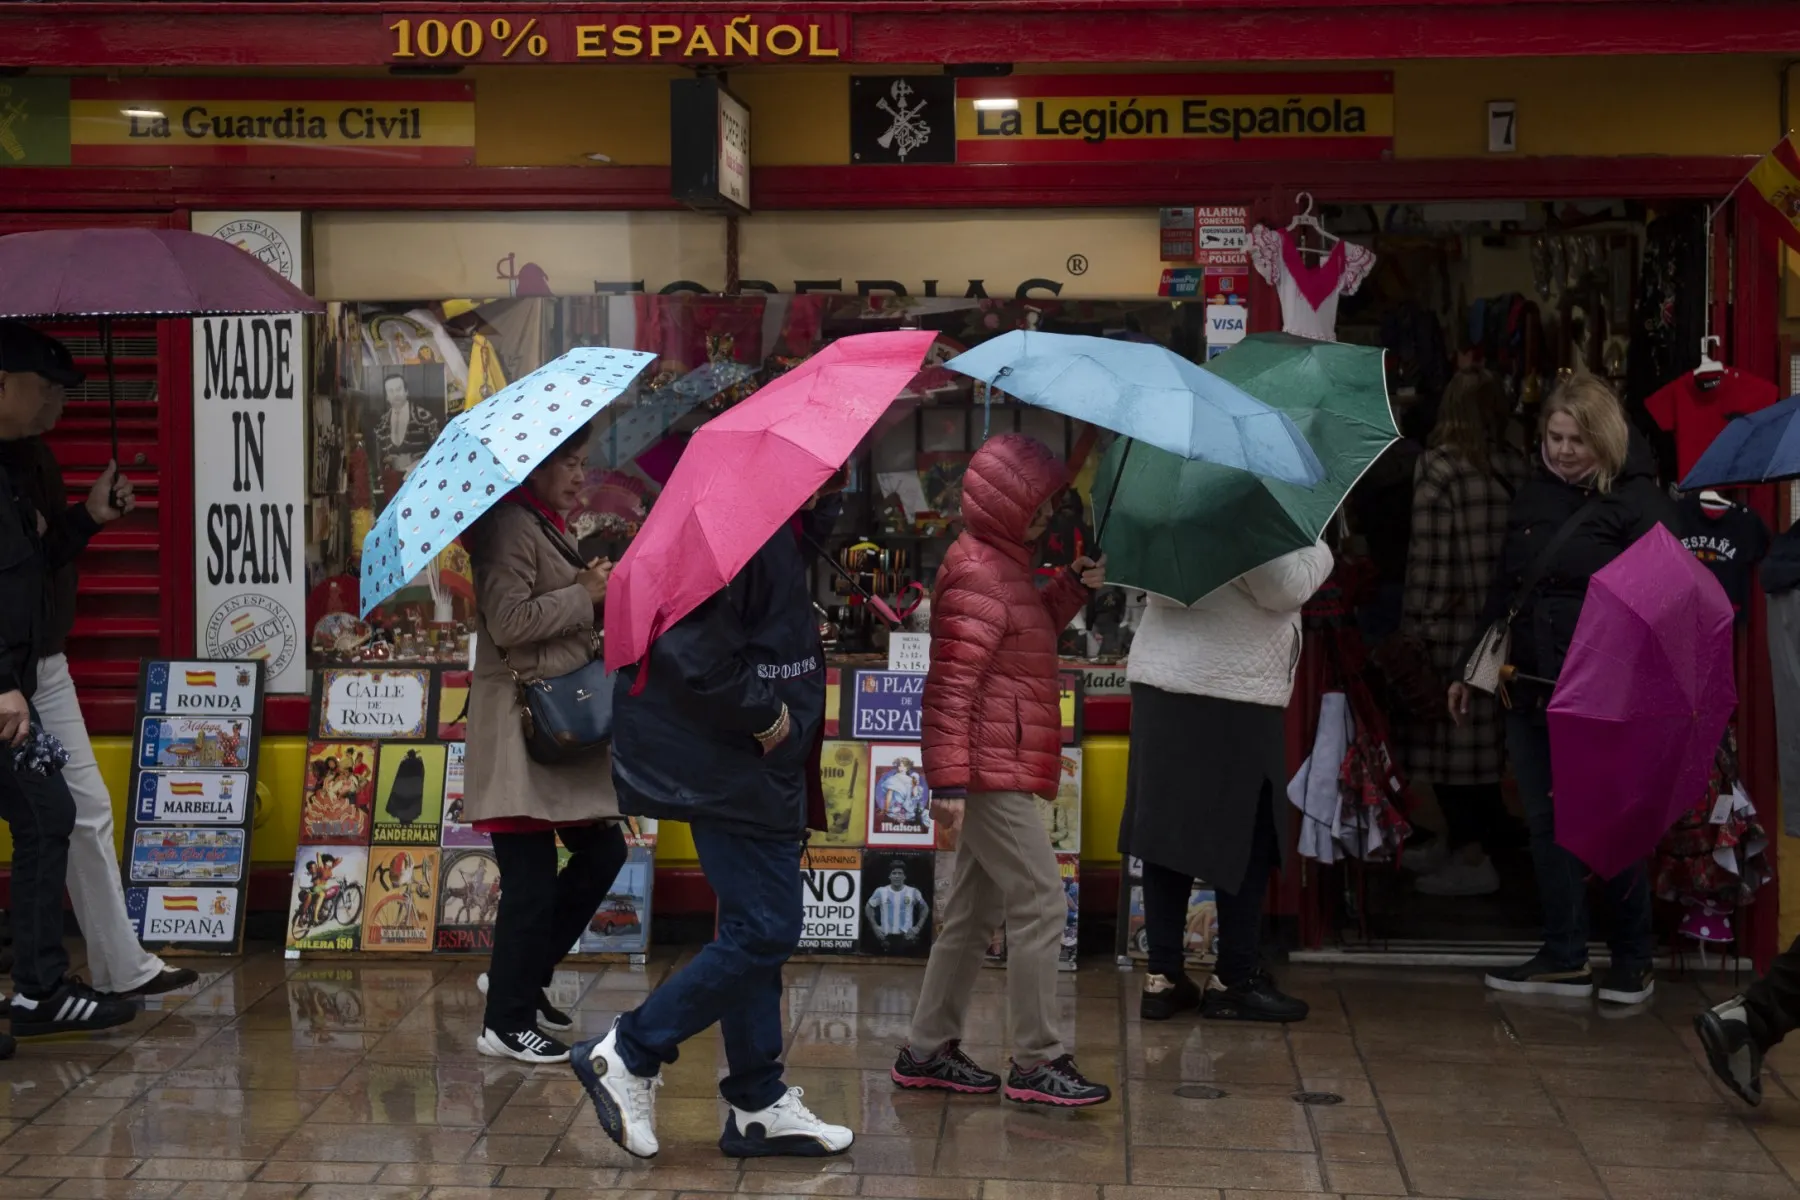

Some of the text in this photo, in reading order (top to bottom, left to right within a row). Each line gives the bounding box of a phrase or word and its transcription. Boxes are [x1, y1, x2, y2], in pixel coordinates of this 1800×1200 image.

[389, 15, 839, 58] 100% ESPAÑOL
[128, 107, 422, 139] La Guardia Civil
[977, 98, 1366, 142] La Legión Española
[1492, 111, 1514, 145] 7
[1198, 207, 1247, 217] ALARMA
[1199, 217, 1245, 225] CONECTADA
[1223, 237, 1244, 246] 24 h
[1212, 318, 1244, 330] VISA
[203, 318, 293, 400] MADE
[232, 411, 265, 492] IN
[207, 502, 293, 585] SPAIN
[1681, 536, 1737, 560] ESPAÑA
[208, 611, 224, 657] HECHO
[224, 599, 240, 612] EN
[221, 619, 281, 659] PRODUCT
[756, 655, 817, 679] SPORTS
[895, 660, 901, 669] 3
[346, 681, 405, 698] CALLE
[883, 677, 923, 694] PLAZ
[150, 692, 242, 710] E RONDA
[367, 701, 382, 710] DE
[901, 697, 913, 706] DE
[341, 709, 405, 726] RONDA
[145, 743, 155, 757] E
[142, 798, 234, 814] E MARBELLA
[881, 821, 921, 833] Mahou
[811, 855, 856, 865] WARNING
[800, 871, 855, 903] NO
[150, 915, 225, 935] ESPAÑA
[336, 937, 353, 949] 150
[438, 926, 494, 948] ESPAÑ
[820, 940, 834, 948] THIS
[834, 940, 853, 948] POINT
